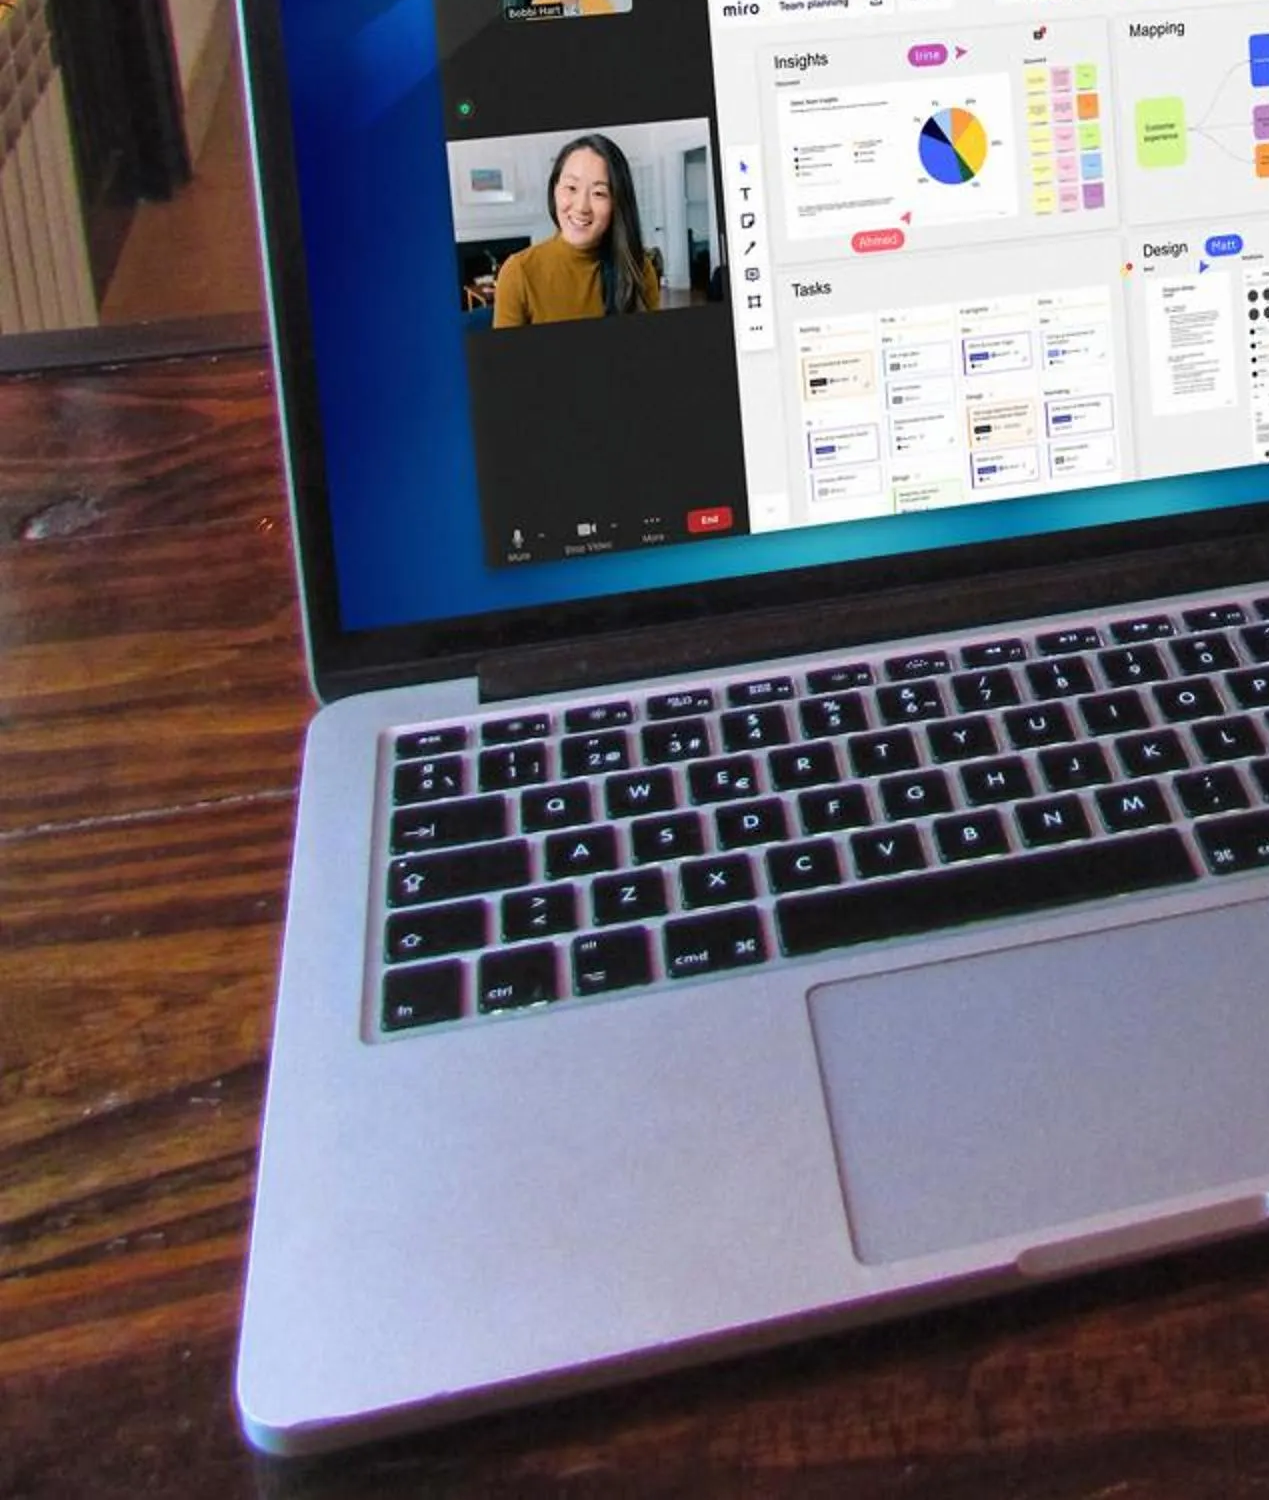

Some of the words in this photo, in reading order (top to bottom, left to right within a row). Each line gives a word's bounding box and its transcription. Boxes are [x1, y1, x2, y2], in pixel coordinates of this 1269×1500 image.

[508, 7, 538, 19] Bobbi
[723, 0, 760, 18] miro
[779, 1, 804, 12] Team
[1128, 21, 1186, 39] Mapping
[774, 53, 829, 71] Insights
[1143, 241, 1189, 259] Design
[791, 281, 832, 298] Tasks
[1252, 678, 1267, 691] P
[1028, 716, 1047, 731] U
[952, 730, 967, 744] Y
[1220, 731, 1235, 744] L
[875, 743, 889, 757] T
[1143, 744, 1161, 758] K
[796, 757, 812, 771] R
[1071, 757, 1080, 771] J
[716, 771, 729, 785] E
[986, 771, 1005, 787] H
[628, 783, 651, 799] W
[906, 785, 925, 800] G
[827, 799, 840, 815] F
[1122, 795, 1145, 812] M
[742, 814, 760, 829] D
[1043, 810, 1063, 827] N
[659, 827, 674, 843] S
[963, 826, 979, 842] B
[572, 843, 590, 858] A
[878, 841, 895, 856] V
[795, 855, 813, 871] C
[709, 871, 726, 887] X
[621, 885, 637, 903] Z
[674, 950, 709, 966] cmd
